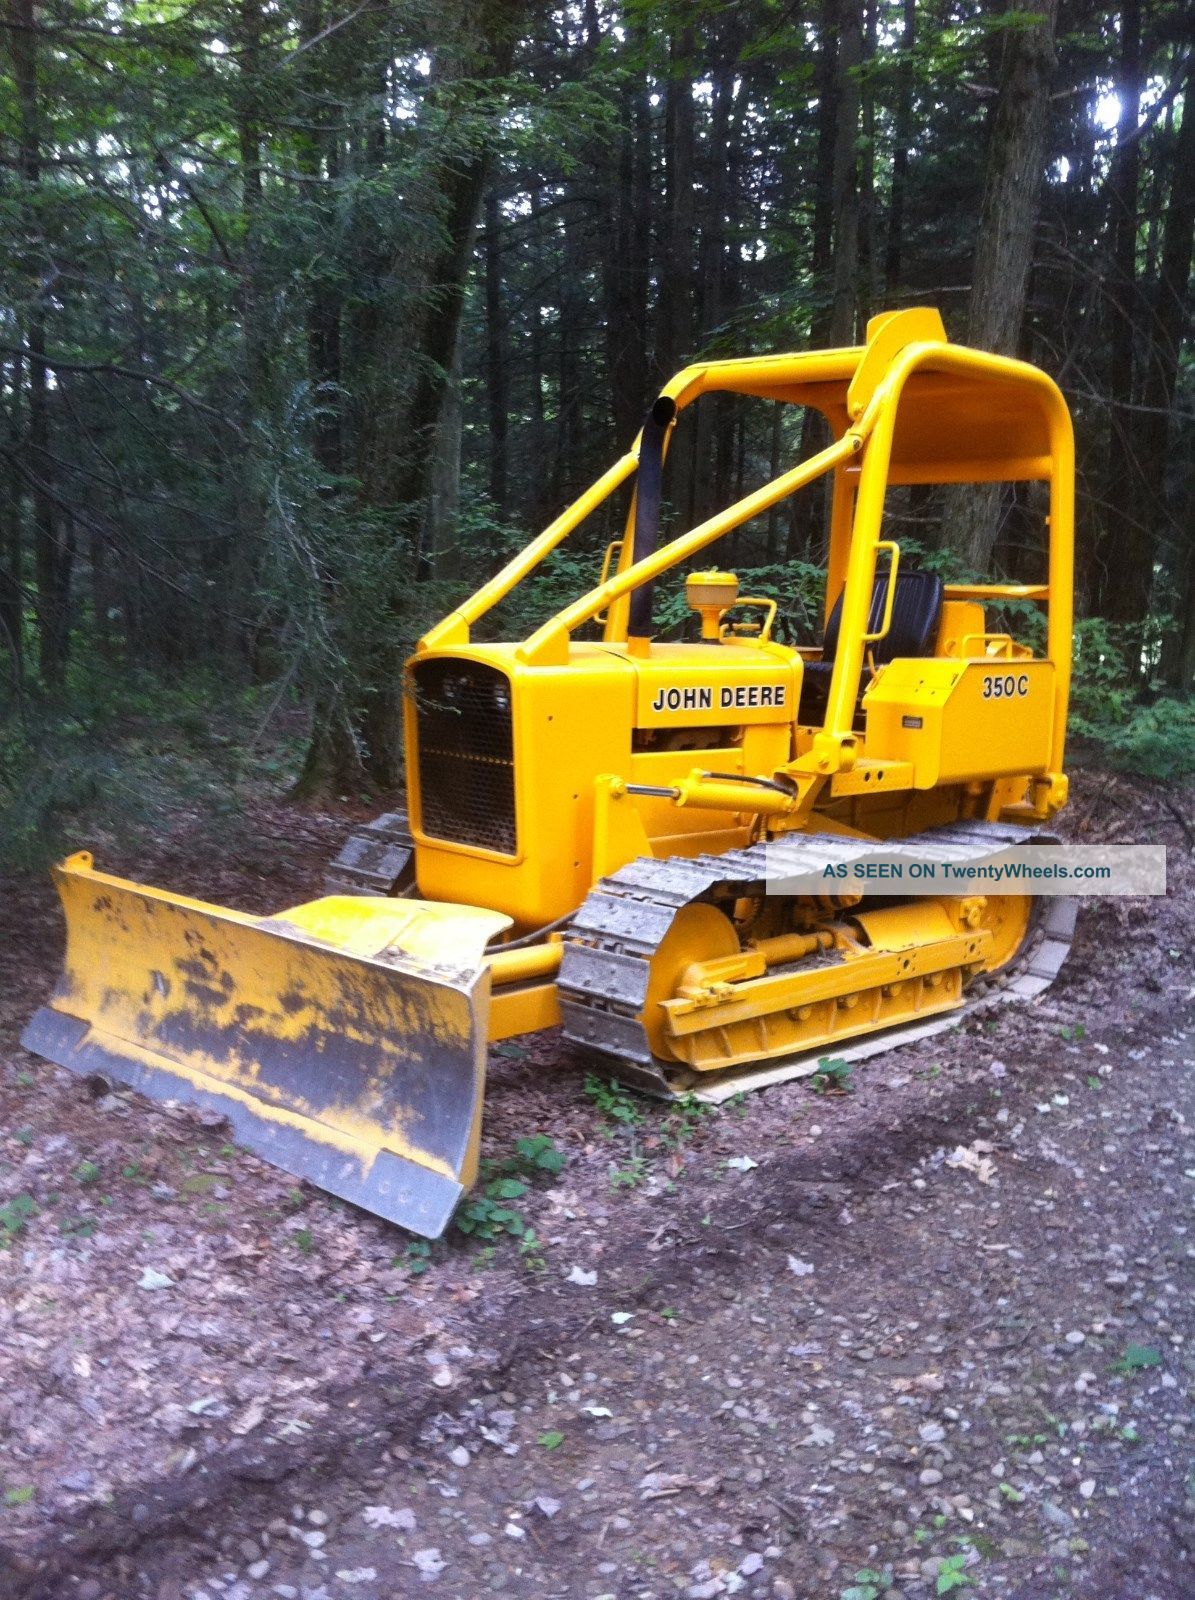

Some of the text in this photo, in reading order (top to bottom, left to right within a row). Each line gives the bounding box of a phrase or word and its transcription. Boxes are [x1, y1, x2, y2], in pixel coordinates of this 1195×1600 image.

[653, 685, 786, 711] JOHN DEERE
[983, 675, 1028, 698] 350C
